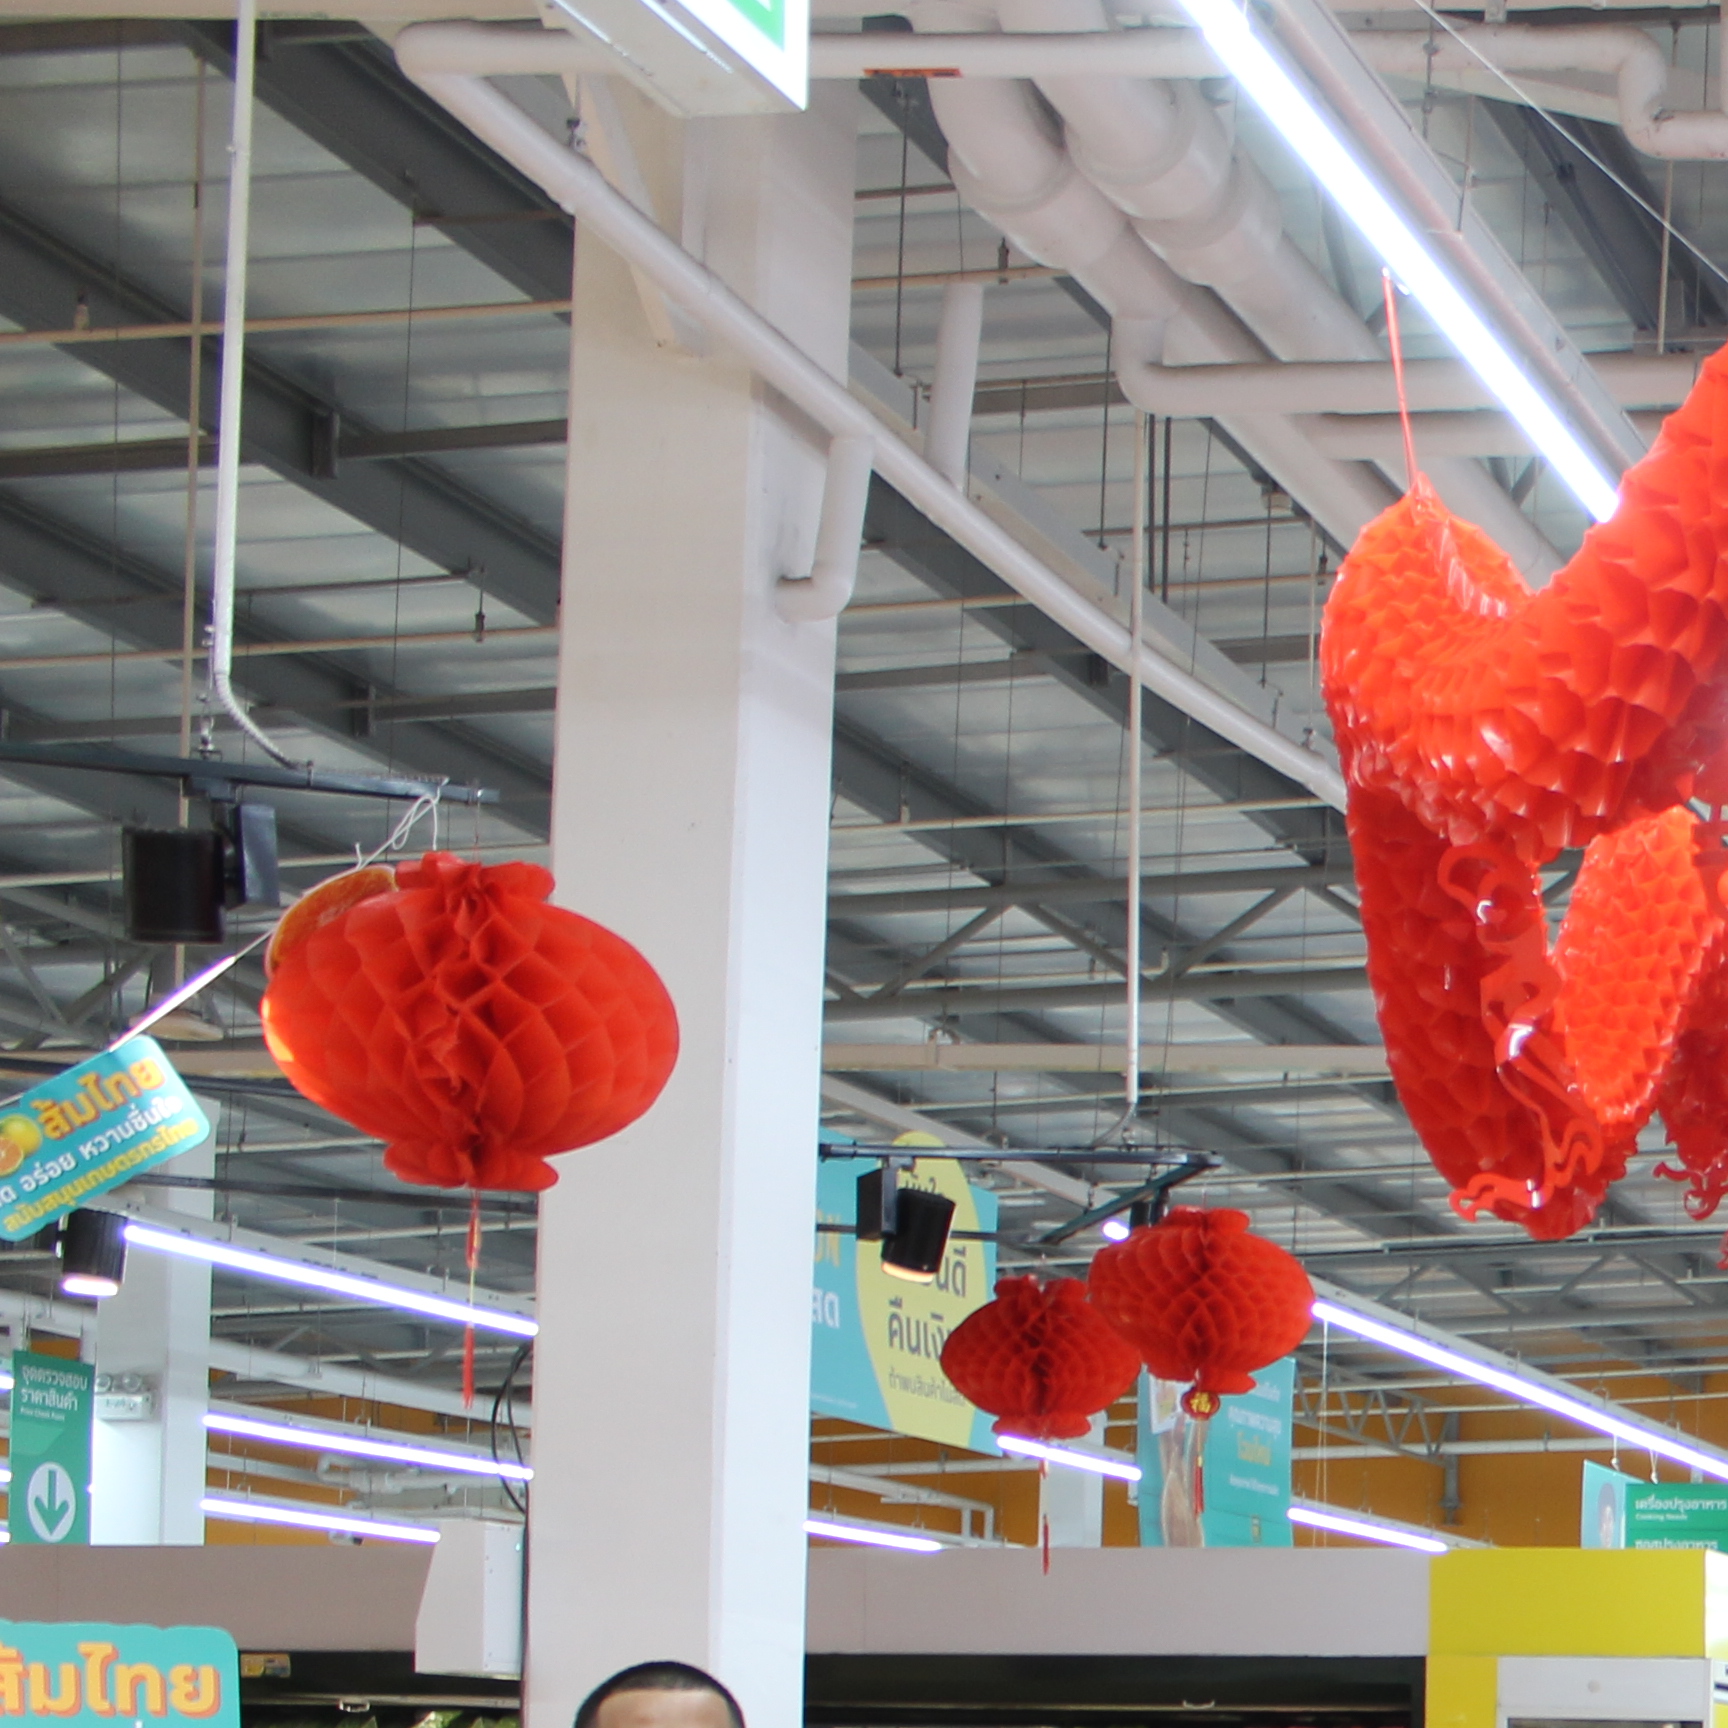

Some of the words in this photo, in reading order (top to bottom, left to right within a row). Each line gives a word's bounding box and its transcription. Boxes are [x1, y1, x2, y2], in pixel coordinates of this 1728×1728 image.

[31, 1057, 165, 1140] ส้มไทย
[20, 1151, 78, 1193] อร่อย
[21, 1387, 78, 1411] ราคาสินค้า
[1634, 1497, 1728, 1513] เครื่องปรุงอาหาร
